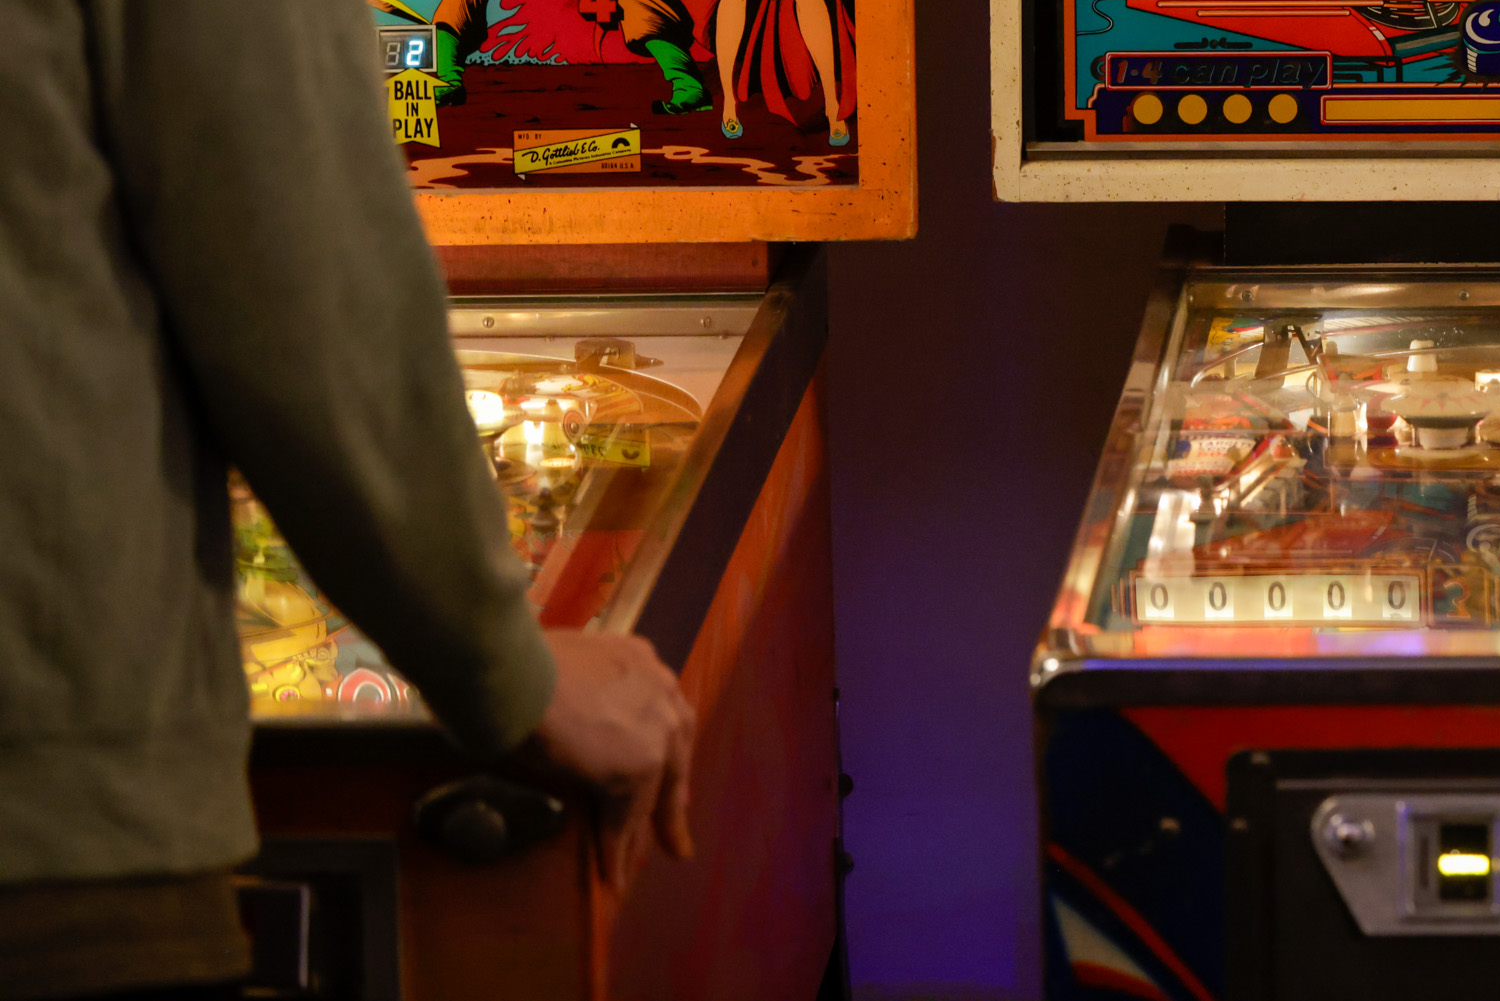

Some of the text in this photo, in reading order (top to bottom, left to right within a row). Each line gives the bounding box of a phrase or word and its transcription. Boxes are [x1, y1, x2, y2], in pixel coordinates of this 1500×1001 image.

[394, 80, 432, 101] BALL
[406, 102, 419, 117] IN
[393, 117, 434, 139] PLAY
[542, 143, 580, 166] Gottlieb
